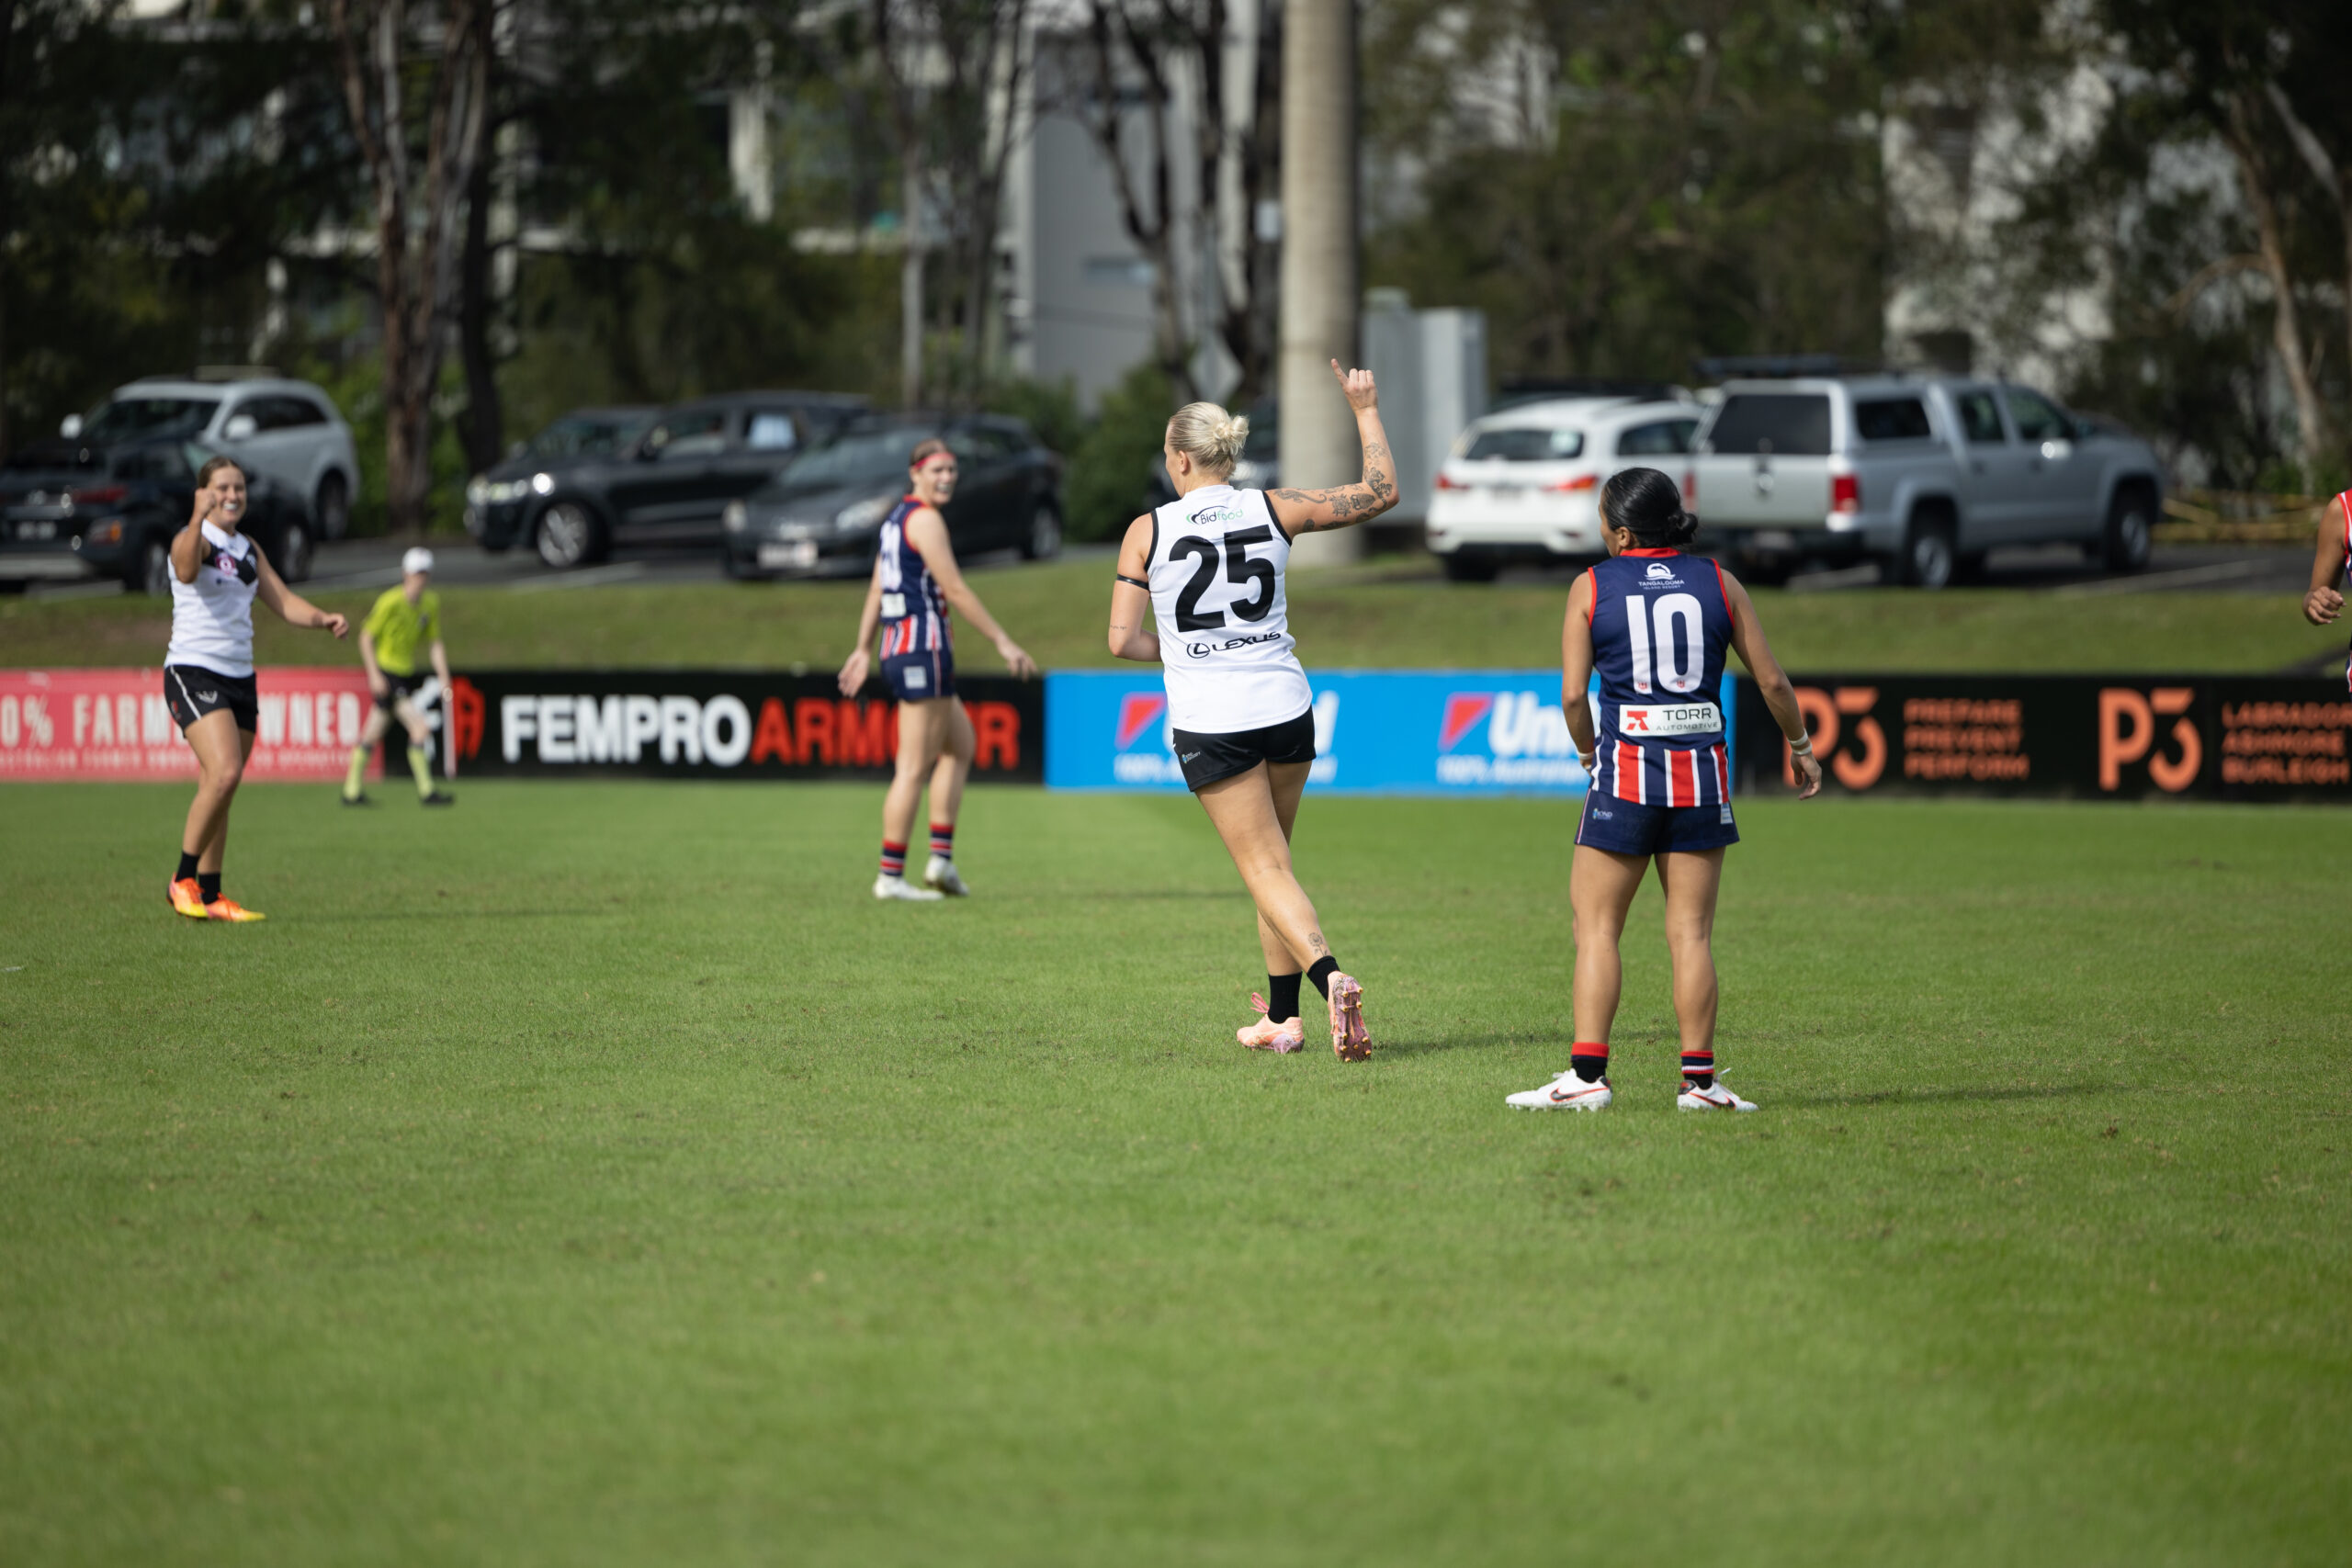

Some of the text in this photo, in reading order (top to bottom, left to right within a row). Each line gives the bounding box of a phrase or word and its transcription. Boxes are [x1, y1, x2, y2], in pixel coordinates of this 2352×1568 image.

[1200, 508, 1244, 525] Bidfood
[1168, 524, 1275, 633] 25
[1638, 579, 1685, 587] TANGALOOMA
[1212, 631, 1282, 652] LEXUS
[1625, 592, 1704, 694] 10
[1662, 707, 1712, 721] TORR
[1904, 697, 2023, 724] PREPARE
[500, 694, 752, 767] FEMPRO
[1656, 722, 1718, 731] AUTOMOTIVE
[2098, 686, 2202, 792] P3
